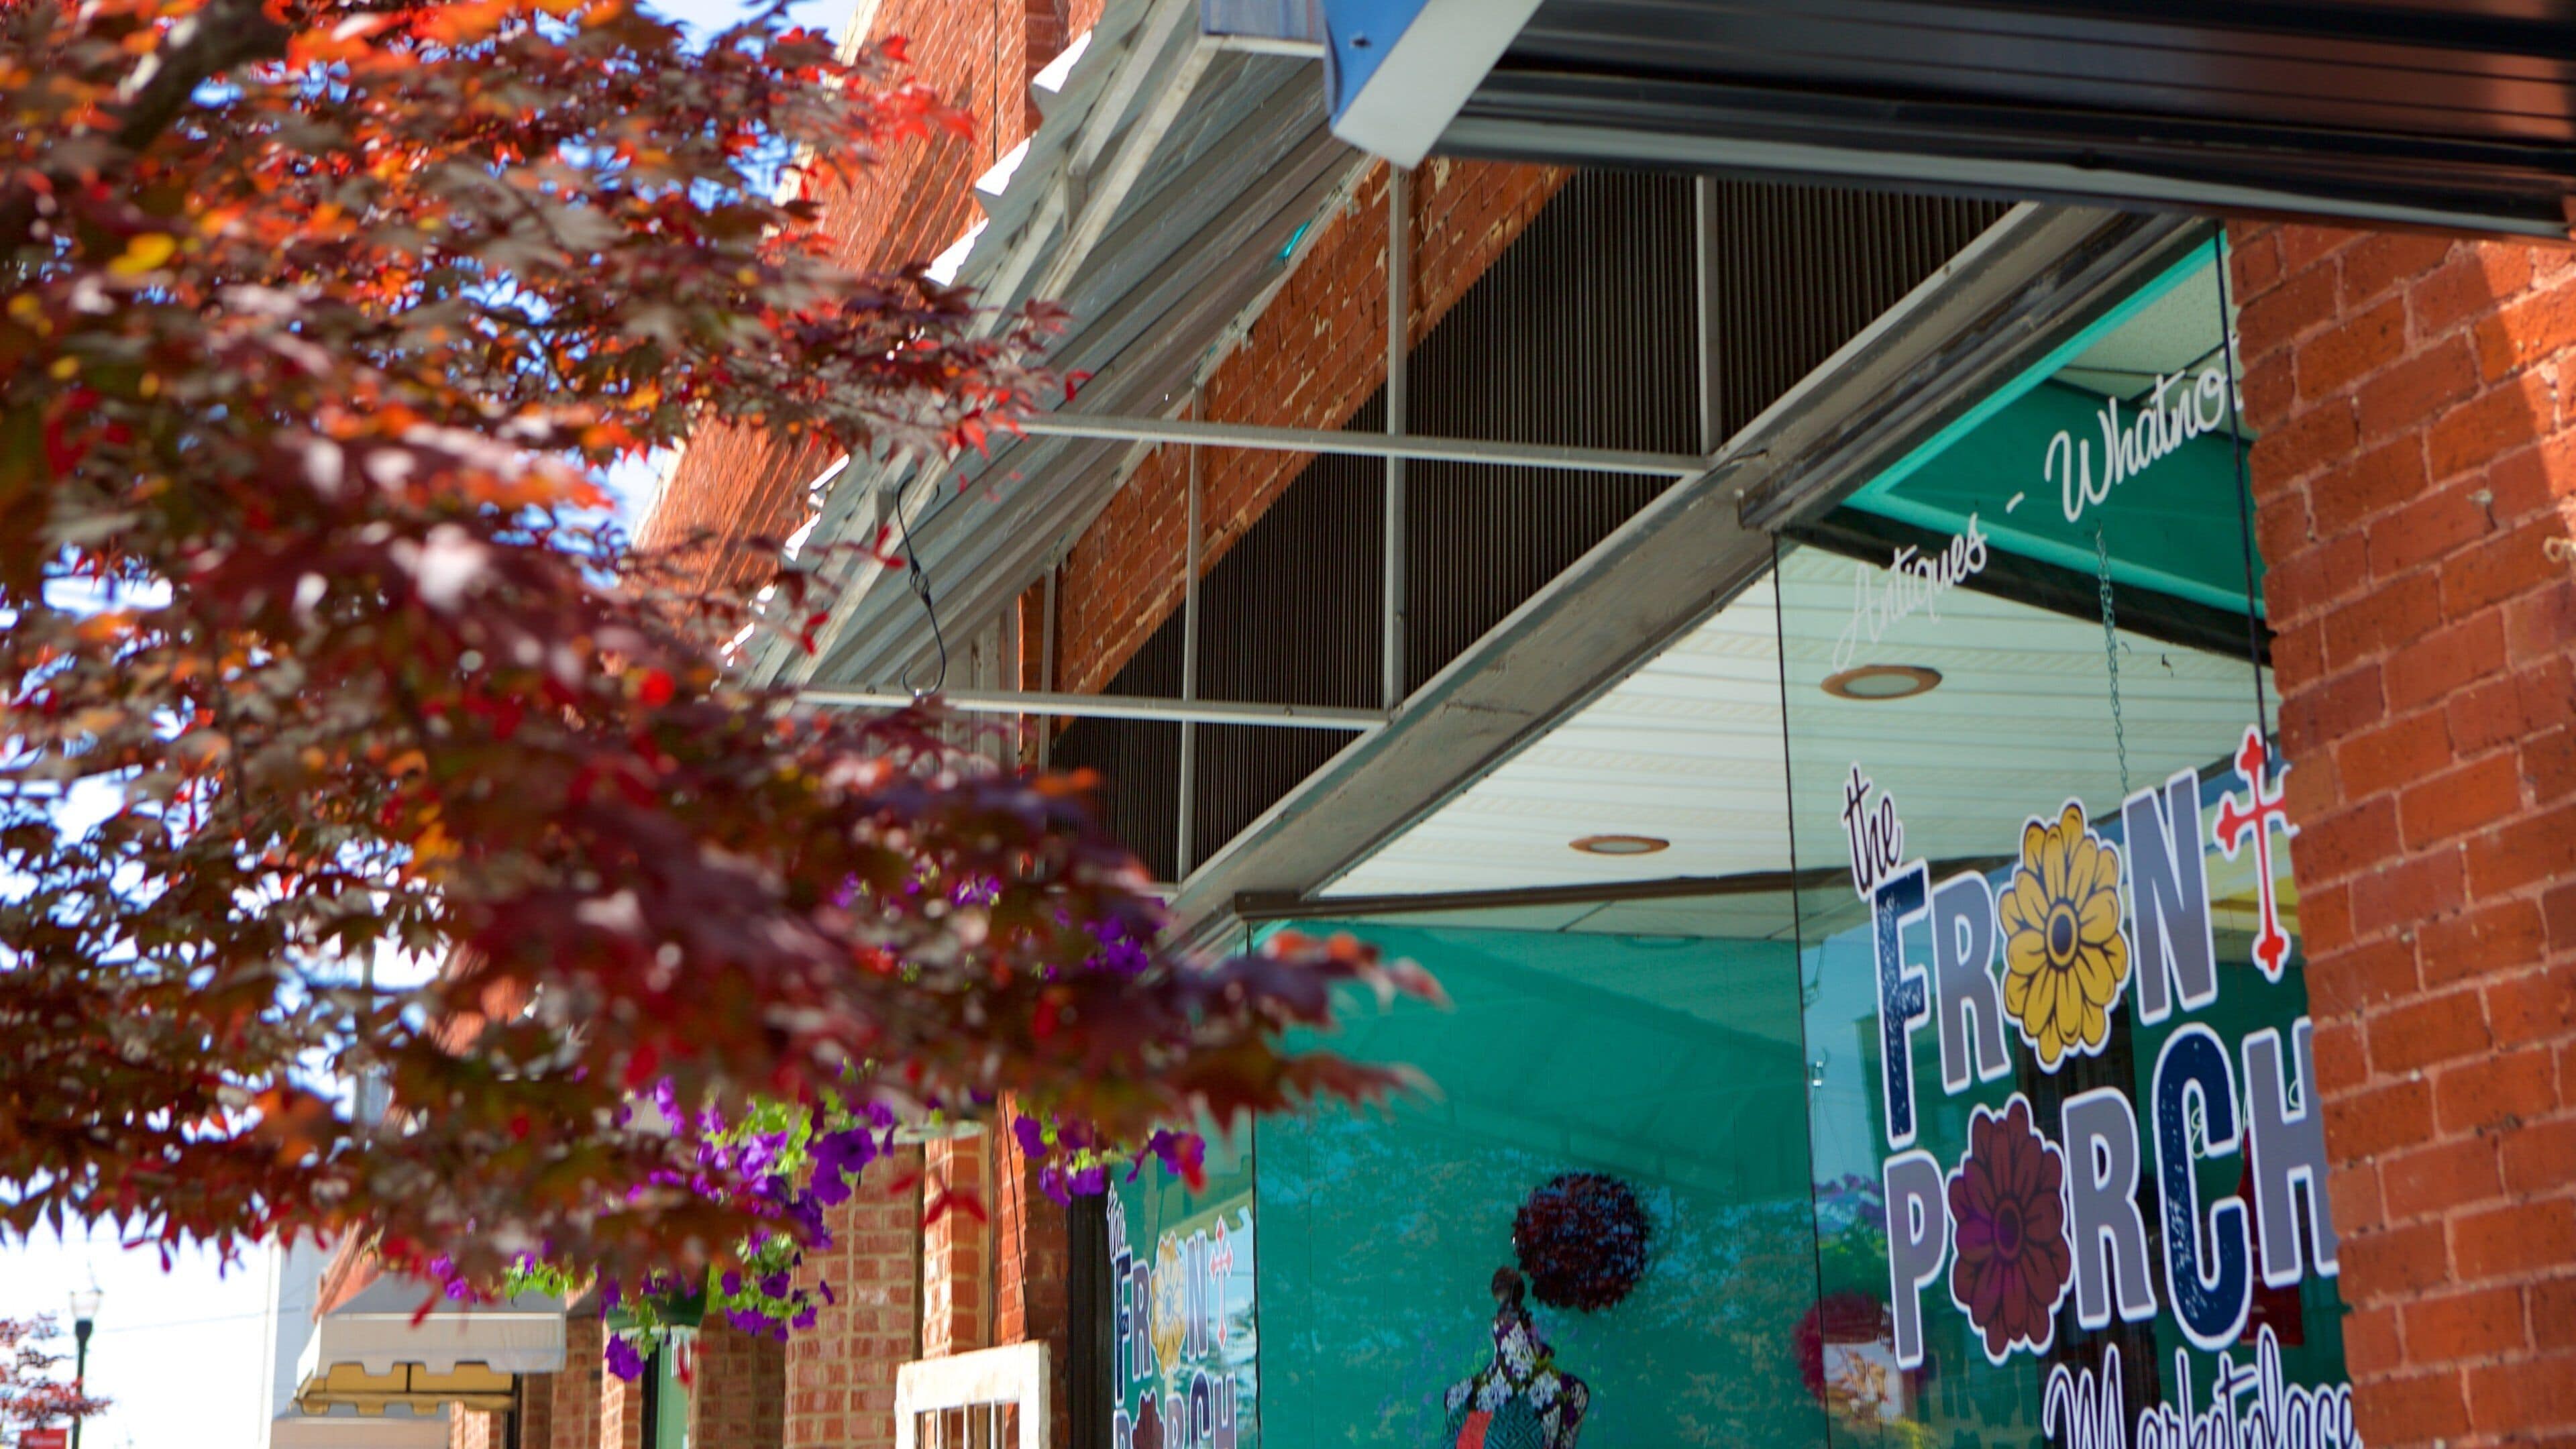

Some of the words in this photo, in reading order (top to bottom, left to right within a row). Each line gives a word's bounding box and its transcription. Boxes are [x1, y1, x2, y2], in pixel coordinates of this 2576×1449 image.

[1833, 512, 1987, 673] Antiques
[1842, 762, 1902, 899] the
[1107, 1180, 1126, 1262] the
[1883, 1016, 2340, 1369] PORCH
